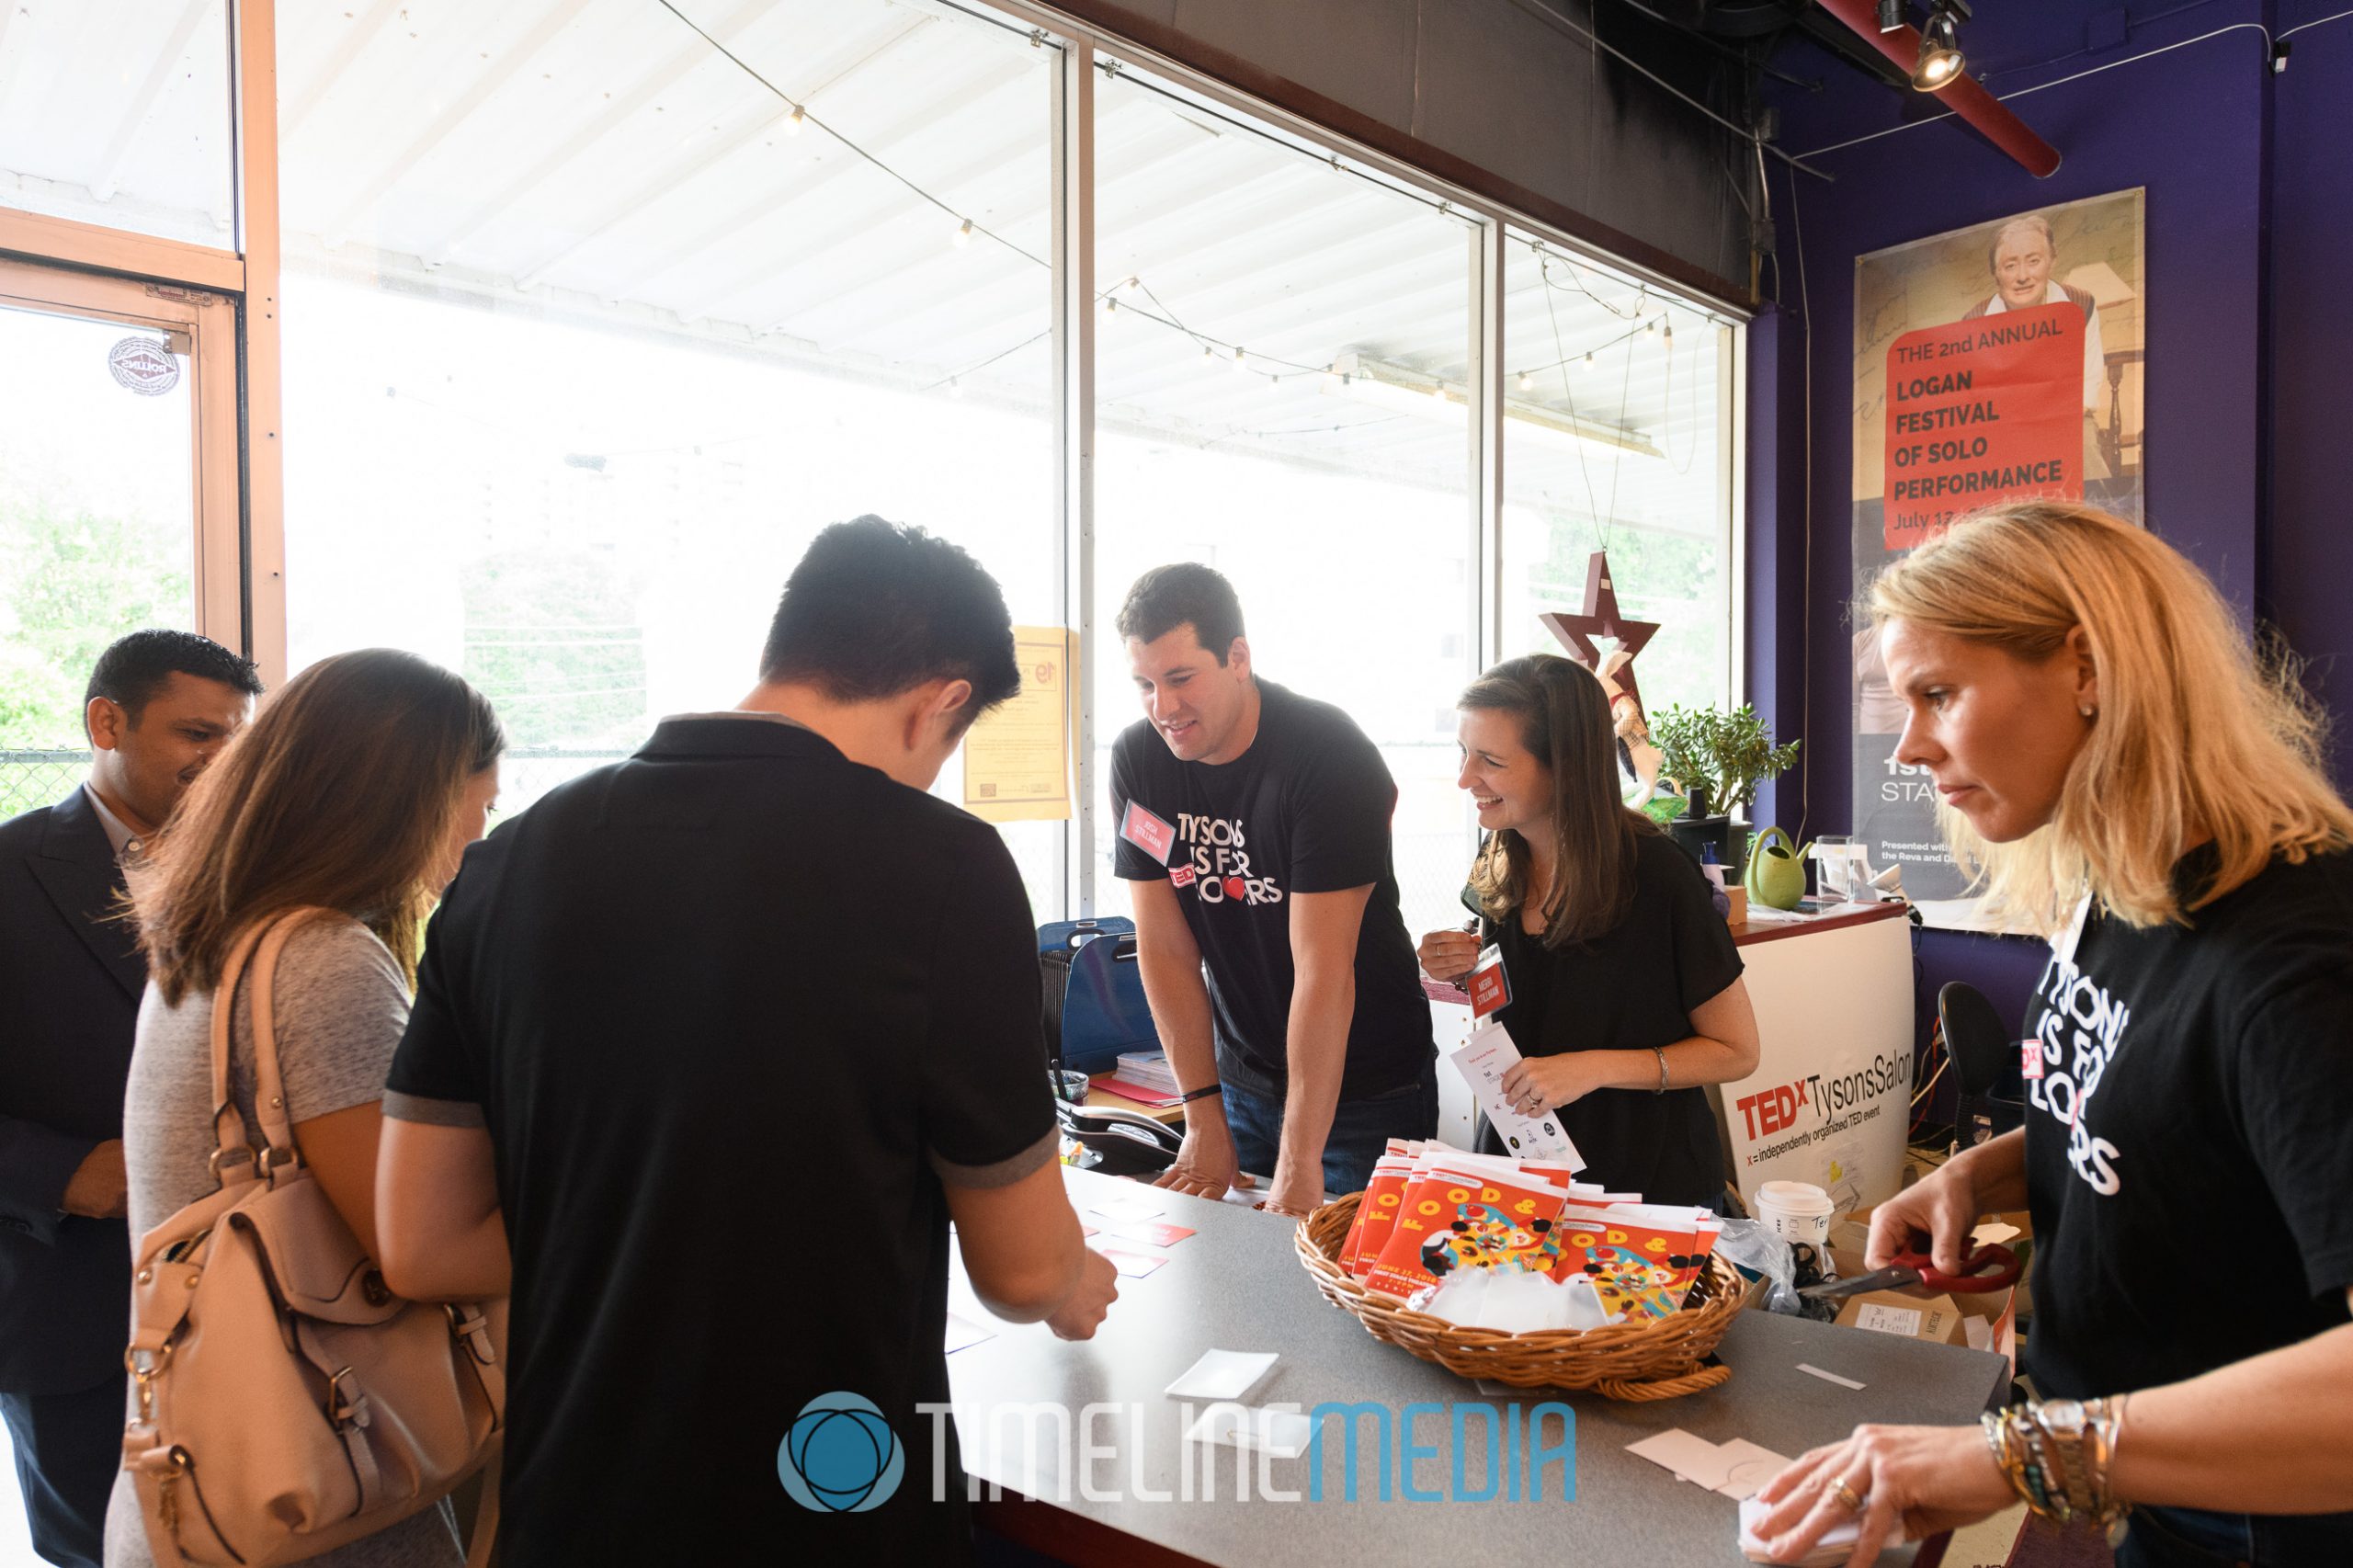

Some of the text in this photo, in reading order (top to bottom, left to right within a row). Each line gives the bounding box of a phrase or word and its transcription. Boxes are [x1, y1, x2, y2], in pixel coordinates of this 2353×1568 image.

[1896, 318, 2063, 365] THE 2nd ANNUAL
[1896, 369, 1972, 402] LOGAN
[1895, 400, 2000, 436] FESTIVAL
[1894, 437, 1988, 468] OF SOLO
[1893, 460, 2063, 501] PERFORMANCE
[1893, 513, 1929, 531] July
[1881, 781, 1937, 802] STA
[1881, 841, 1929, 851] Presented
[1881, 851, 1897, 860] the
[1898, 852, 1922, 862] Reva
[1923, 854, 1942, 863] and
[1758, 1130, 1812, 1163] independently
[1813, 1117, 1848, 1142] organized
[1848, 1110, 1863, 1128] TED
[1863, 1105, 1881, 1123] event
[1402, 1187, 1501, 1232] FOOD
